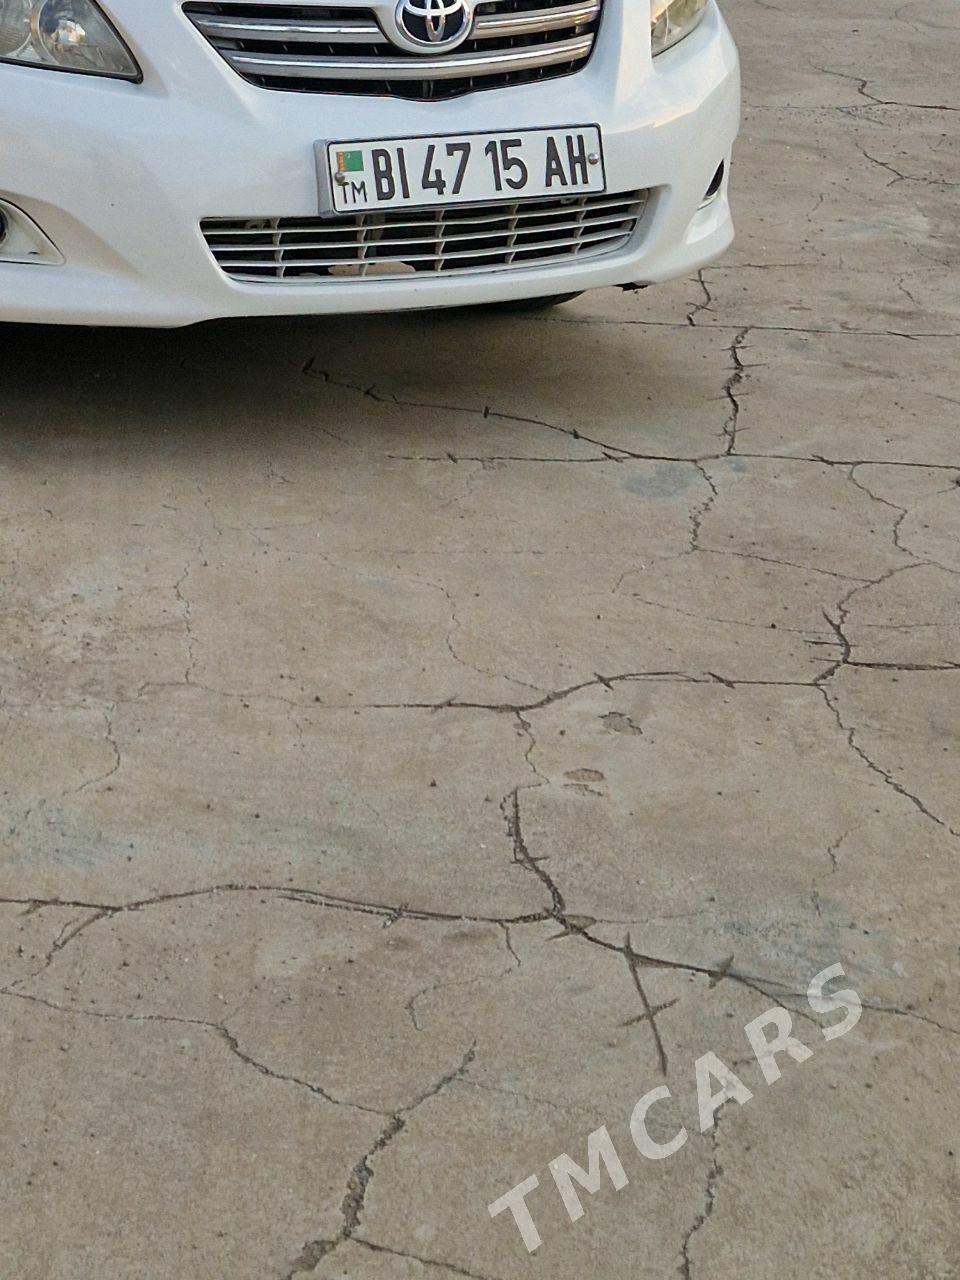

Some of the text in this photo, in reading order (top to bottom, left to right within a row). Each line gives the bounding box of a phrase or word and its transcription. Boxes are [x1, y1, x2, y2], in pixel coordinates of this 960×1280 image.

[371, 134, 589, 200] BI 47 15 AH
[339, 180, 368, 204] TM
